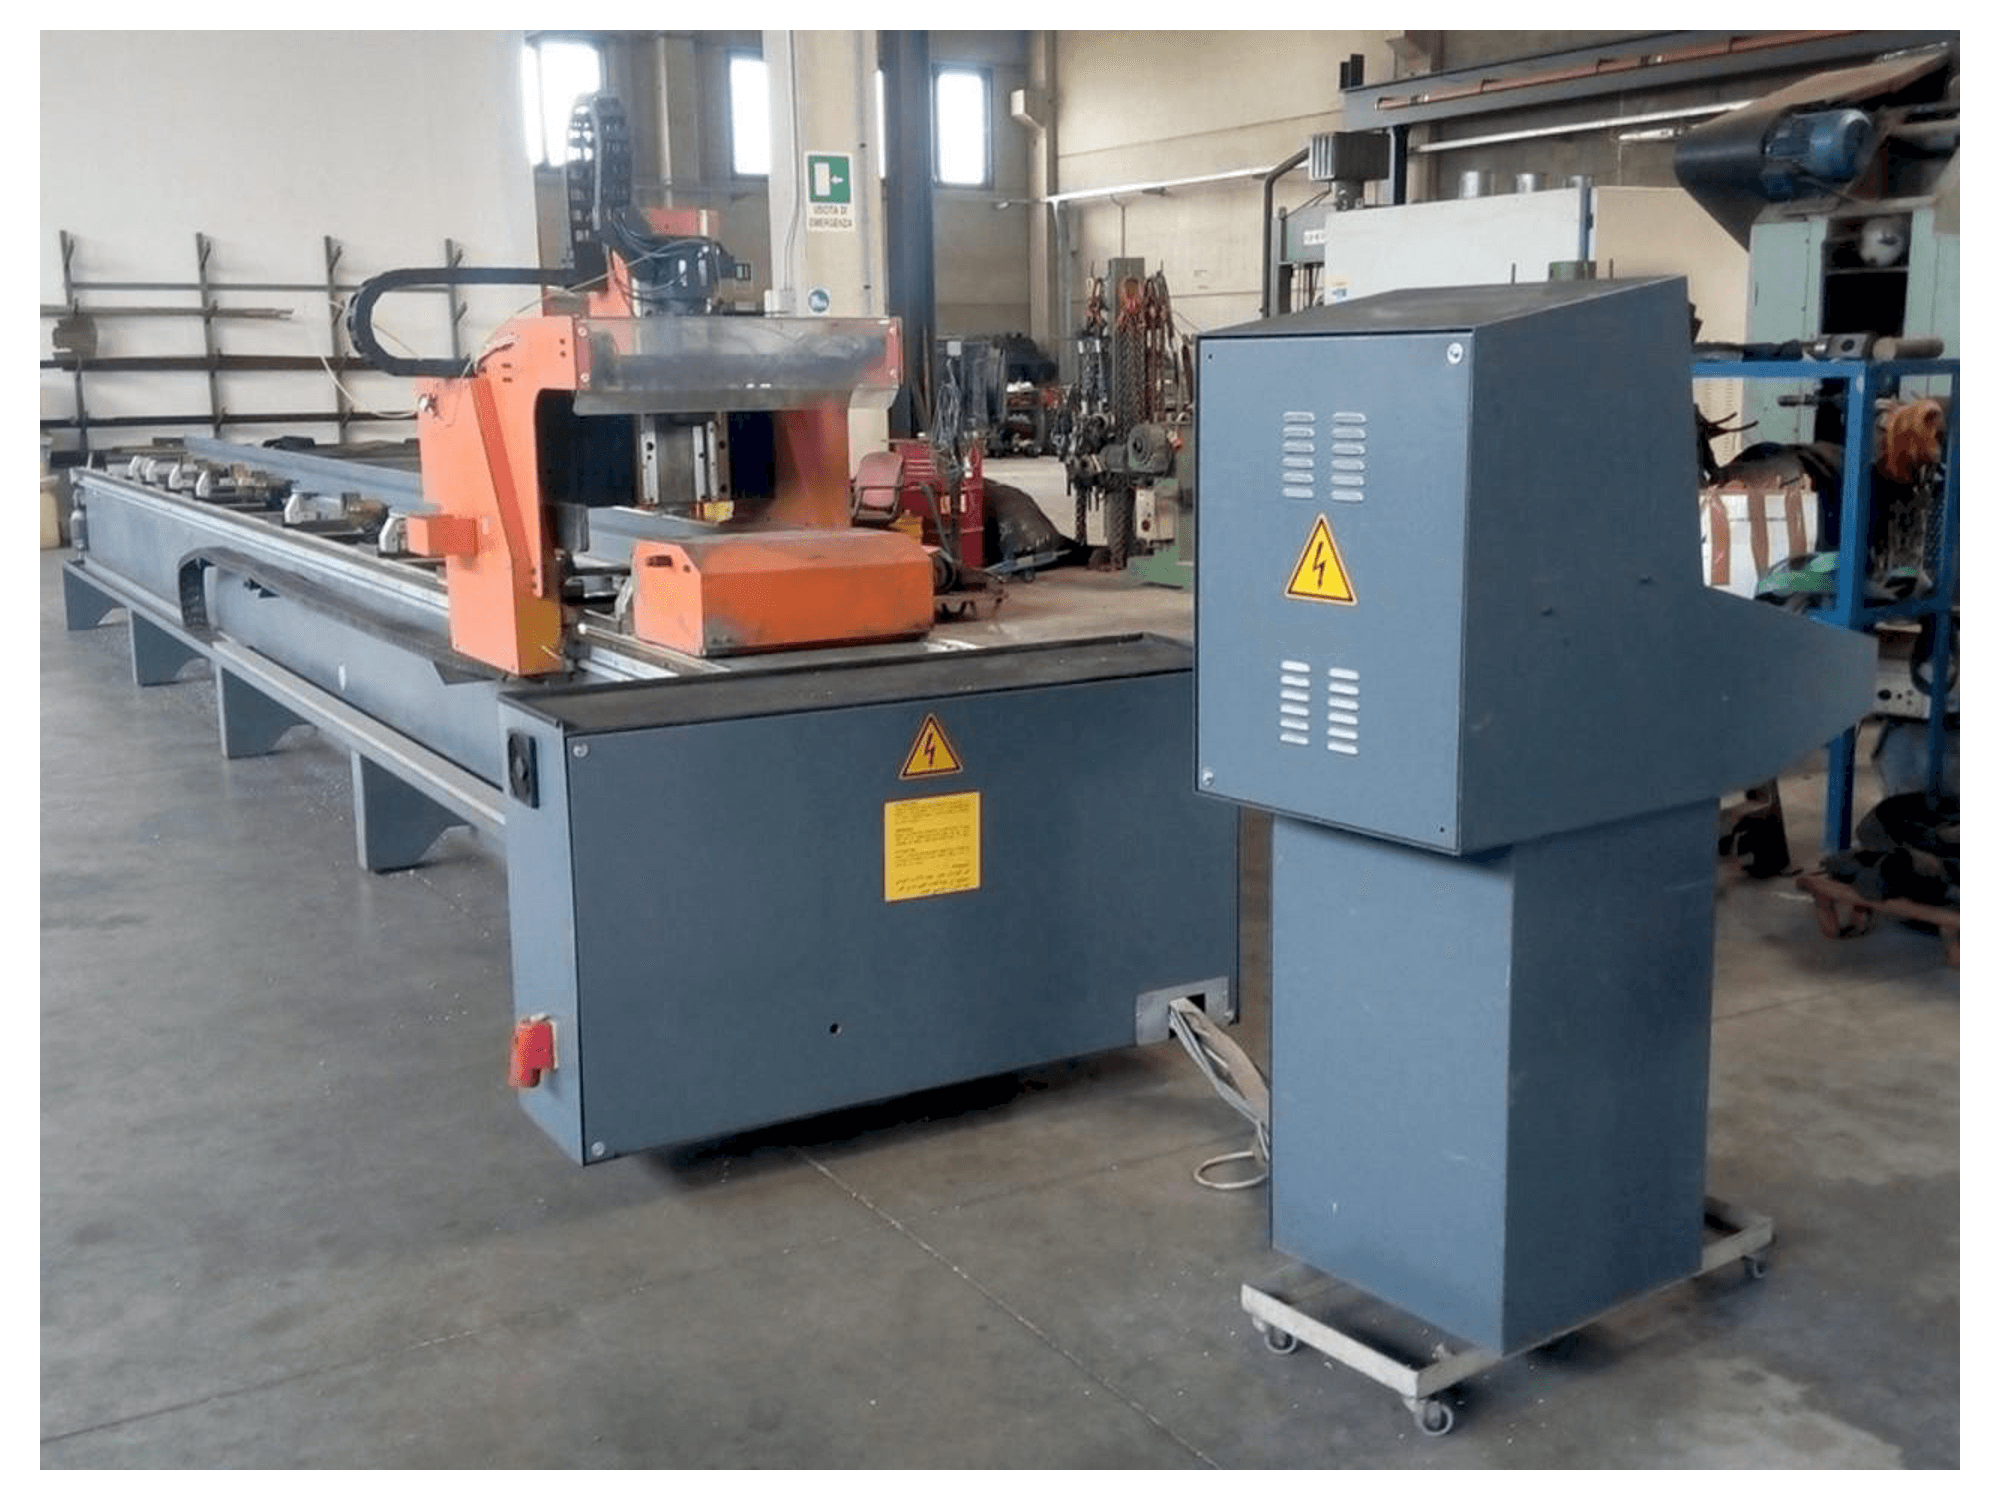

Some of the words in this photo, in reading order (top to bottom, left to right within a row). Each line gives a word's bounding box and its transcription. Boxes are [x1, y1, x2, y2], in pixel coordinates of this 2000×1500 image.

[813, 205, 838, 215] USCITA
[840, 205, 848, 215] DI
[809, 217, 853, 227] EMERGENZA
